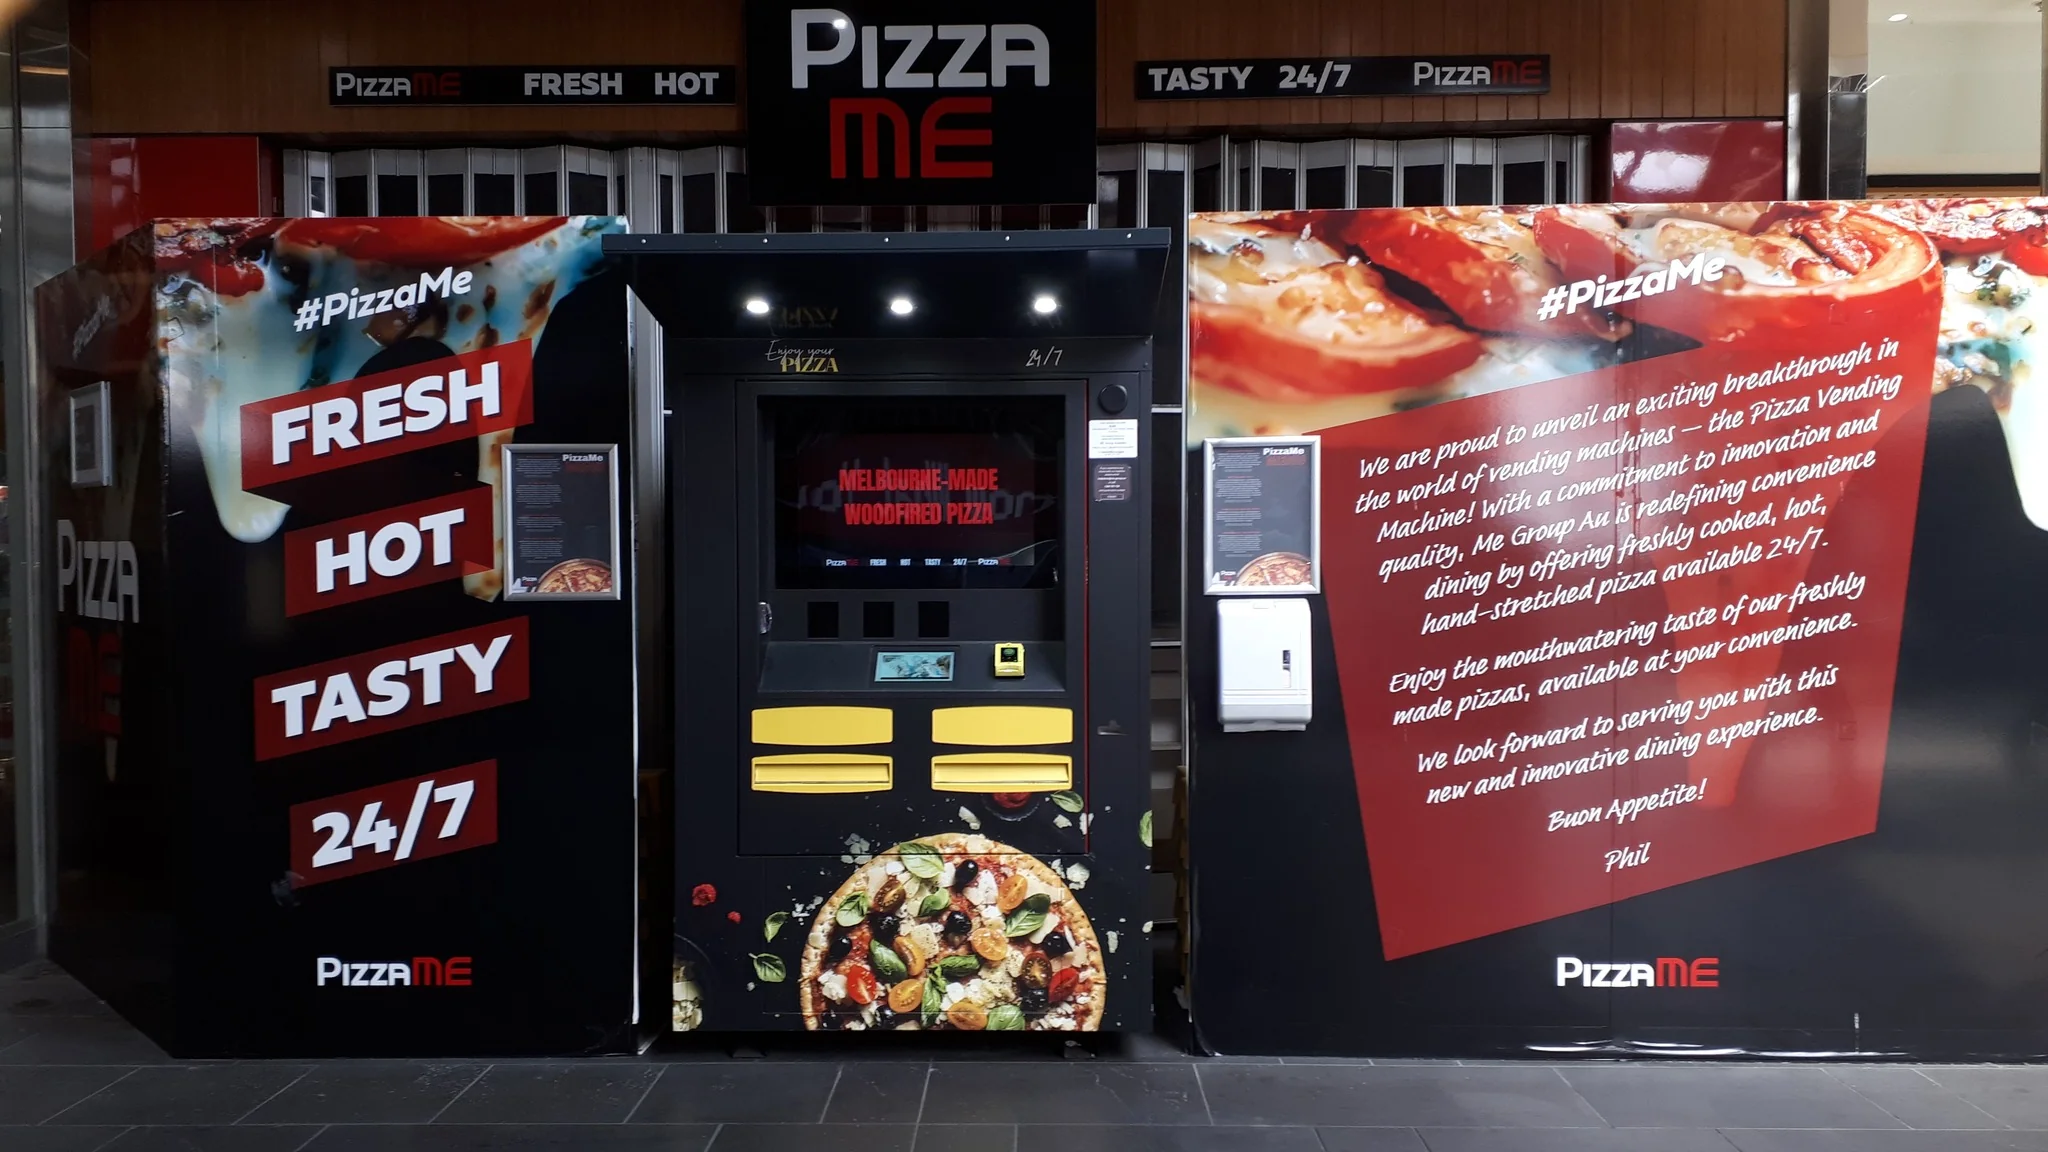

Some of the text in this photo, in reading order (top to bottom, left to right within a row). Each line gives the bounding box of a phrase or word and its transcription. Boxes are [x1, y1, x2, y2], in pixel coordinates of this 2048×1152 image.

[524, 72, 622, 96] FRESH
[655, 72, 719, 96] HOT
[791, 8, 1050, 88] PIZZA
[1148, 66, 1253, 92] TASTY
[1279, 61, 1352, 93] 24/7
[830, 96, 992, 178] ME
[293, 266, 473, 332] #PizzaMe
[1536, 252, 1726, 322] #PizzaMe
[765, 338, 834, 366] Enjoy your
[781, 358, 838, 372] PIZZA
[1025, 346, 1062, 367] 24/7
[272, 361, 500, 465] FRESH
[1354, 490, 1390, 514] the
[1396, 470, 1458, 504] world
[1460, 462, 1488, 494] of
[1488, 450, 1572, 482] vending
[1576, 428, 1675, 462] machines
[1708, 408, 1744, 434] the
[1750, 396, 1812, 424] Pizza
[1818, 374, 1904, 408] Vending
[1360, 338, 1900, 478] We are proud to unveil an exciting breakthrough in
[839, 468, 998, 492] MELBOURNE-MADE
[844, 502, 942, 525] WOODFIRED
[947, 502, 994, 525] PIZZA
[1376, 408, 1880, 542] Machine! With a commitment to innovation and
[316, 508, 464, 593] HOT
[1378, 450, 1876, 584] quality, Me Group Au is redefining convenience
[1424, 494, 1826, 600] dining by offering freshly cooked, hot,
[58, 520, 140, 624] PIZZA
[1594, 570, 1658, 604] pizza
[1662, 542, 1762, 582] available
[1766, 526, 1828, 560] 24/7.
[1390, 572, 1866, 694] Enjoy the mouthwatering taste of our freshly
[1392, 612, 1858, 726] made pizzas, available at your convenience.
[271, 634, 512, 738] TASTY
[1418, 664, 1840, 772] We look forward to serving you with this
[1426, 706, 1824, 804] new and innovative dining experience.
[312, 780, 475, 868] 24/7
[1548, 778, 1708, 832] Buon Appetite!
[1604, 842, 1652, 872] Phil
